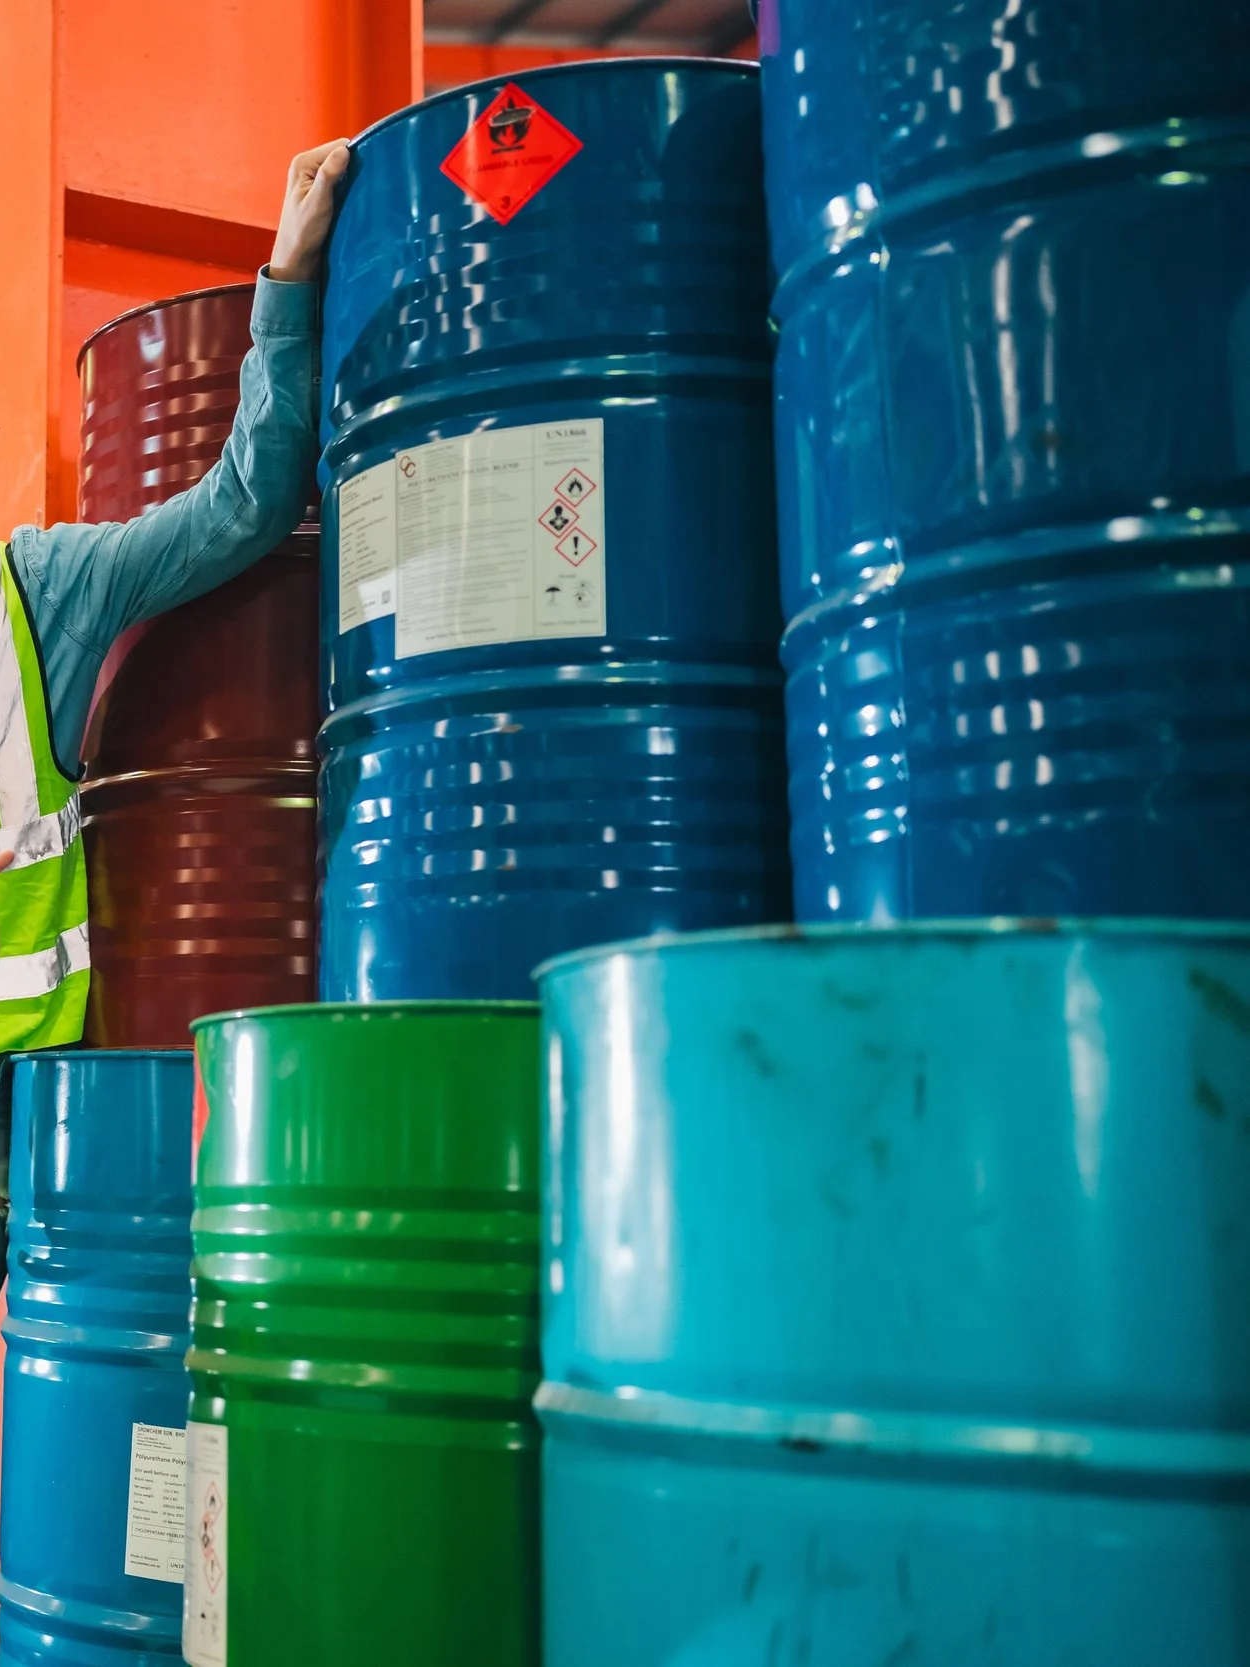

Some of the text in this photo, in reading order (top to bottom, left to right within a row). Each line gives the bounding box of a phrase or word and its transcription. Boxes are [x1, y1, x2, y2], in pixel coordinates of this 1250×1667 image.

[501, 196, 511, 209] 3
[137, 1427, 162, 1435] GROWCHEM
[135, 1453, 170, 1463] Polyurethane
[166, 1531, 185, 1539] PREBLEN
